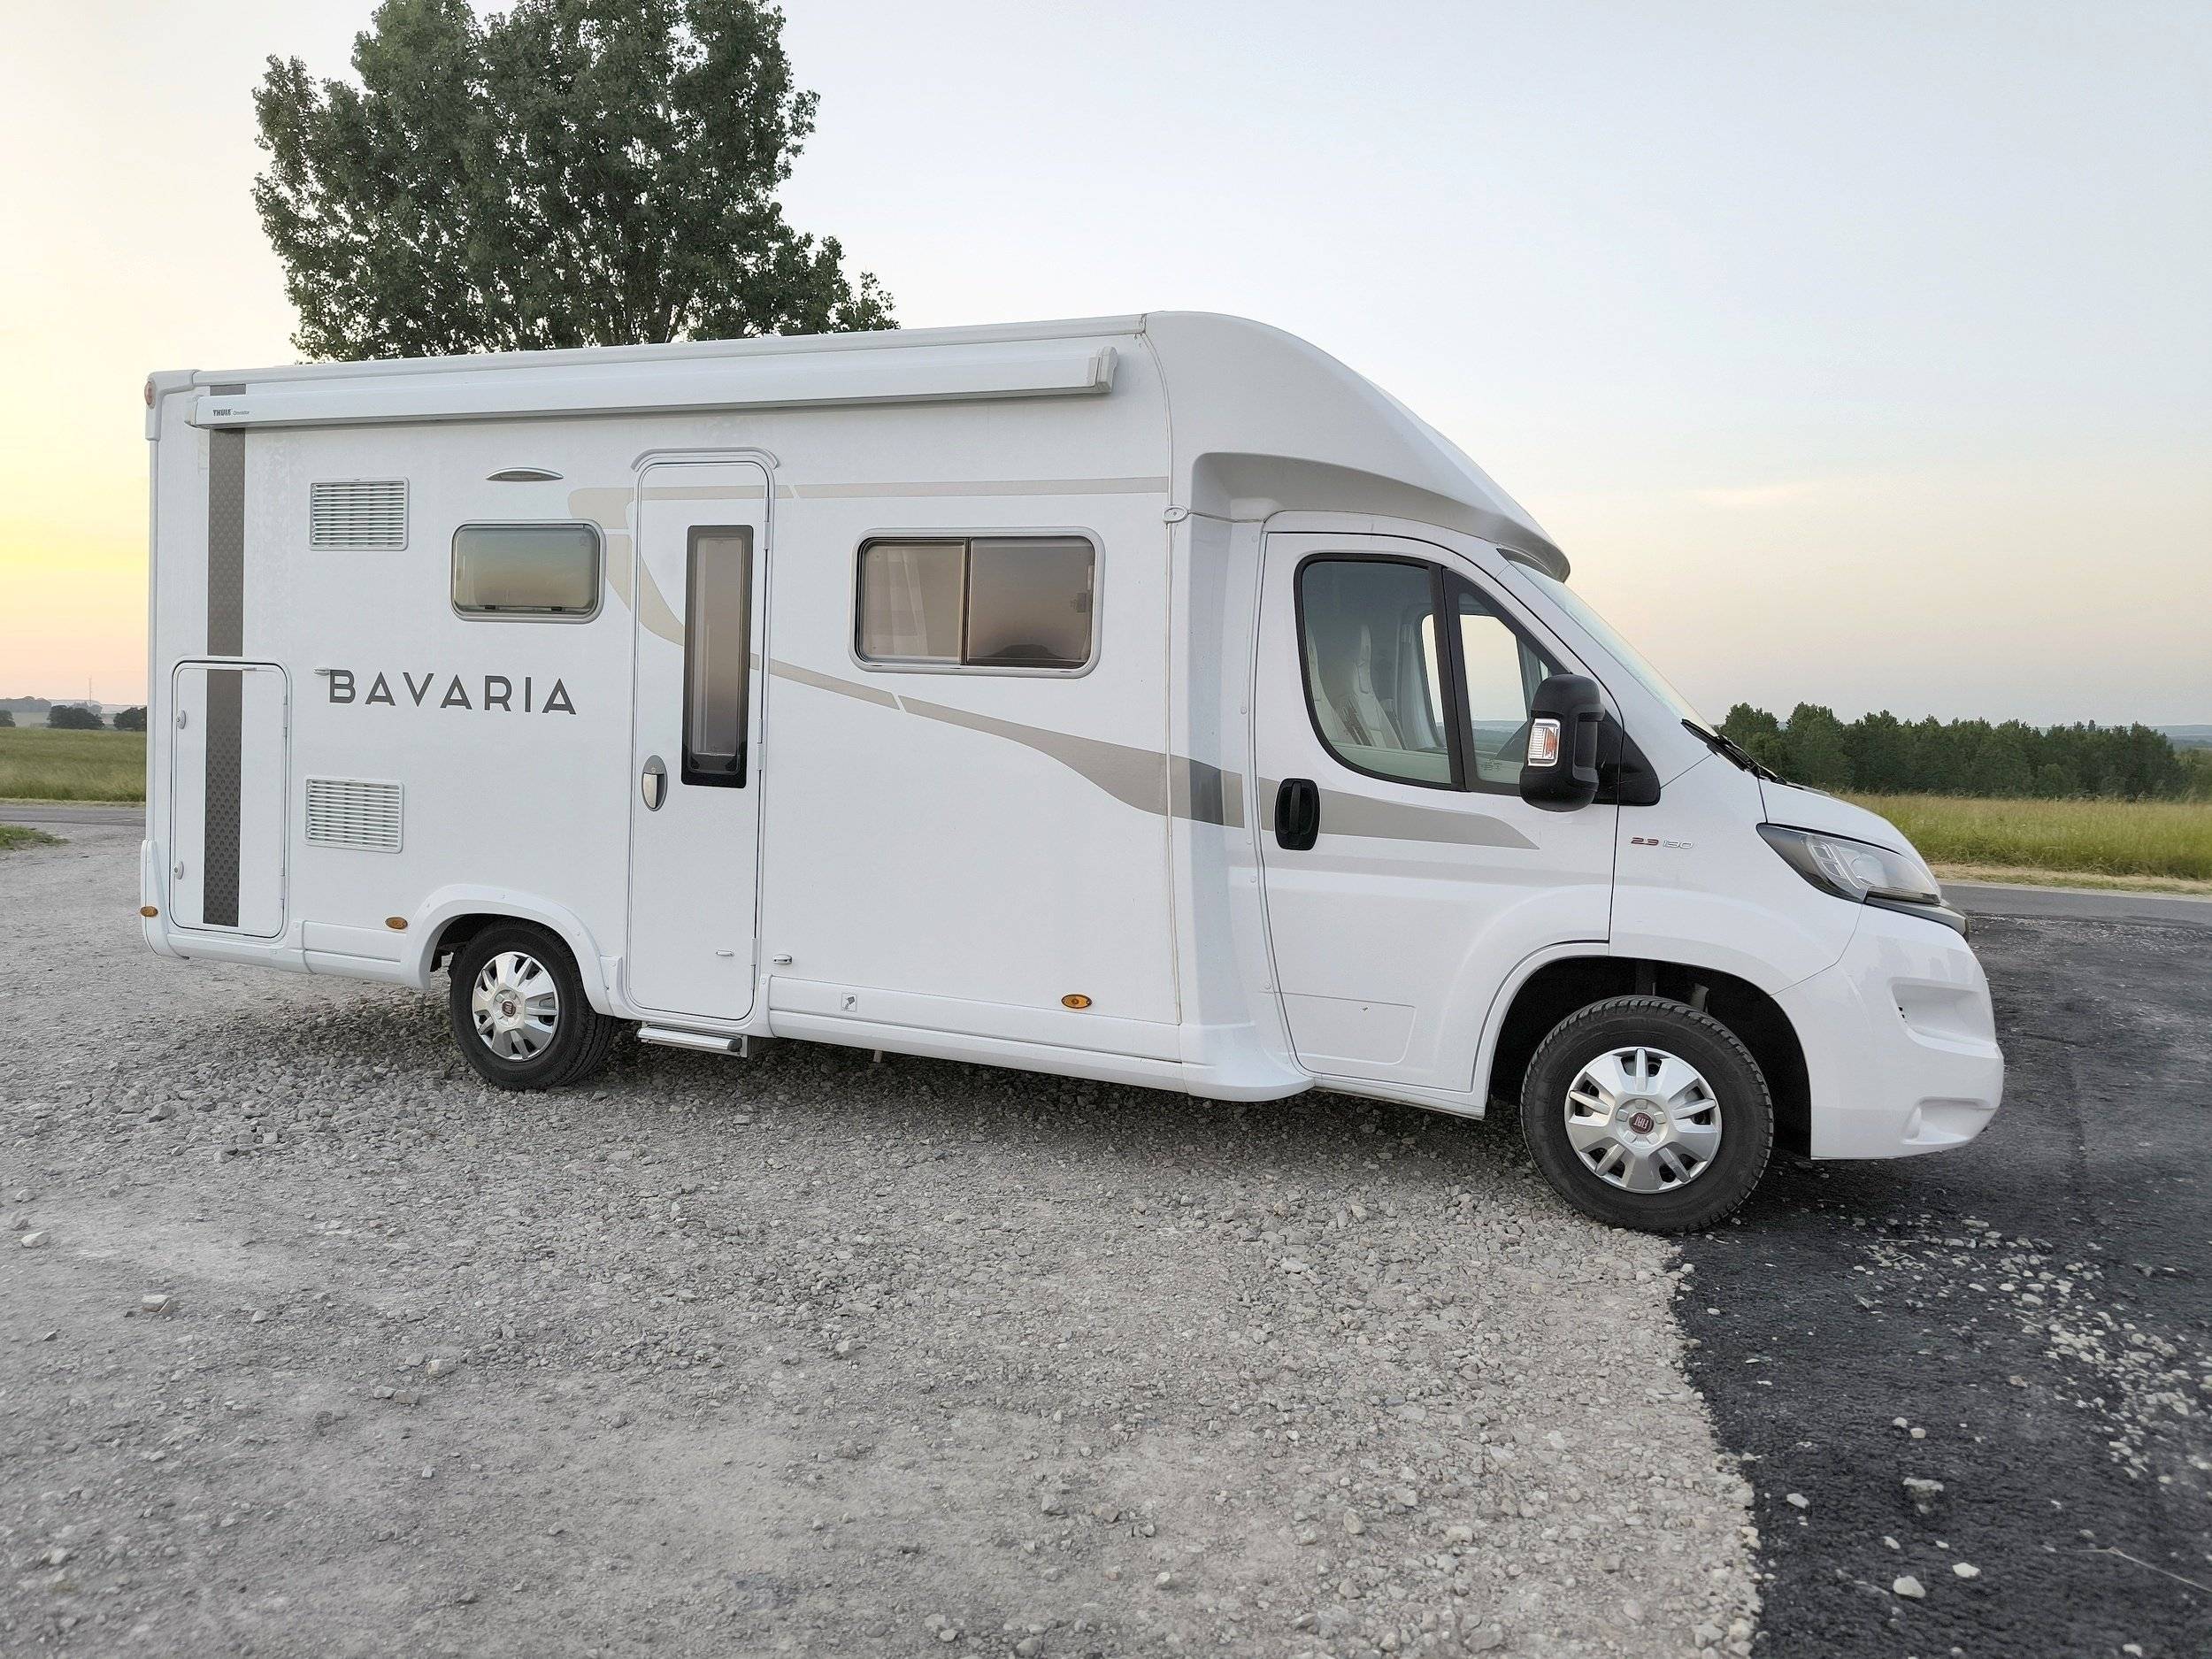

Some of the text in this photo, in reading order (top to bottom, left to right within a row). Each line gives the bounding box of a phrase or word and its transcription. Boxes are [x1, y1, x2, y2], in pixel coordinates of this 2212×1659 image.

[329, 669, 577, 715] BAVARIA
[1663, 840, 1694, 849] 130
[1633, 1116, 1649, 1129] FIAT
